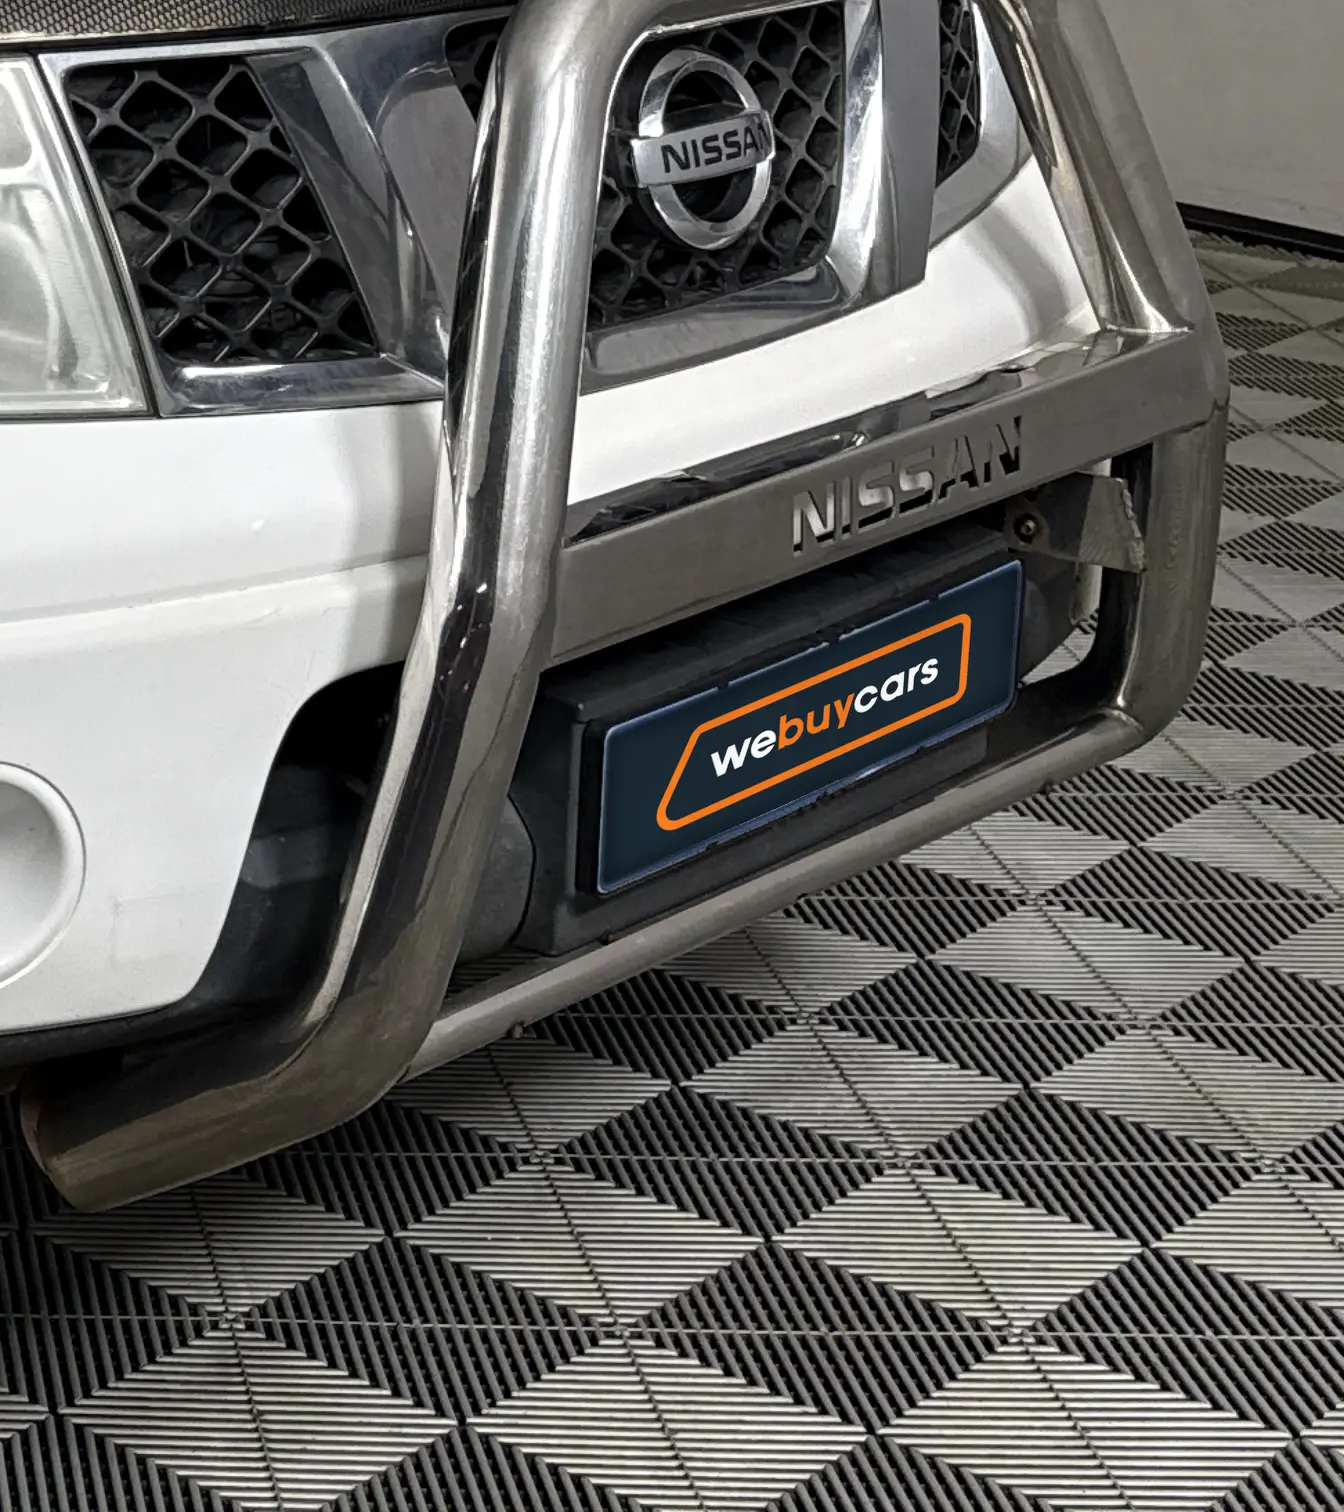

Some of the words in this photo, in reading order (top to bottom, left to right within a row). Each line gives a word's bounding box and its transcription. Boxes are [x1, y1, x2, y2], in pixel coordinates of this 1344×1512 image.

[661, 122, 773, 174] NISSAN
[791, 415, 1023, 557] NISSAN
[710, 657, 940, 779] webuycars
